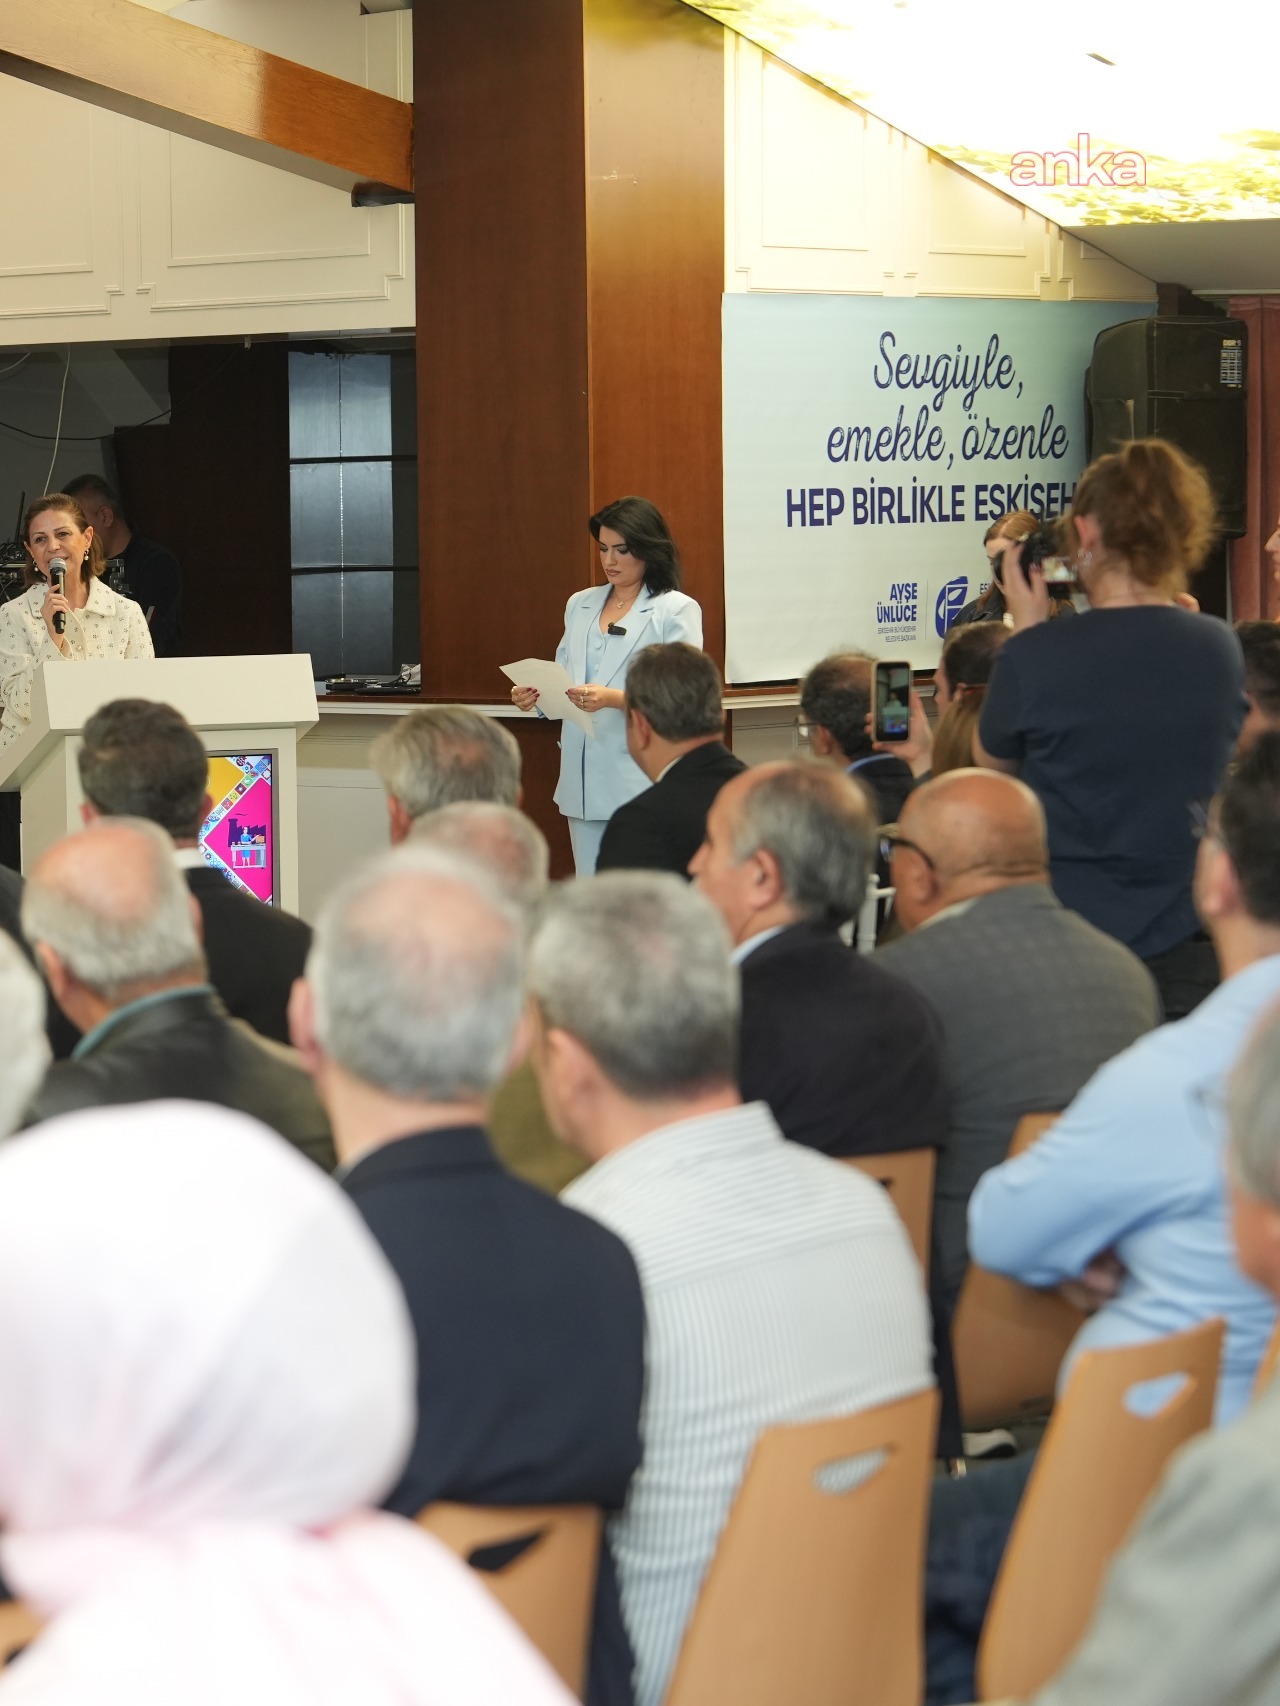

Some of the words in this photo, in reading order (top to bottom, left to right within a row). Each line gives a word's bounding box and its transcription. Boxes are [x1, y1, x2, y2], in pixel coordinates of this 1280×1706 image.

[874, 331, 1023, 412] Sevgiyle,
[827, 405, 954, 470] emekle,
[962, 404, 1069, 460] özenle
[786, 488, 845, 527] HEP
[852, 476, 965, 525] BİRLİKLE
[876, 601, 917, 623] ÜNLÜCE
[889, 582, 918, 603] AYŞE
